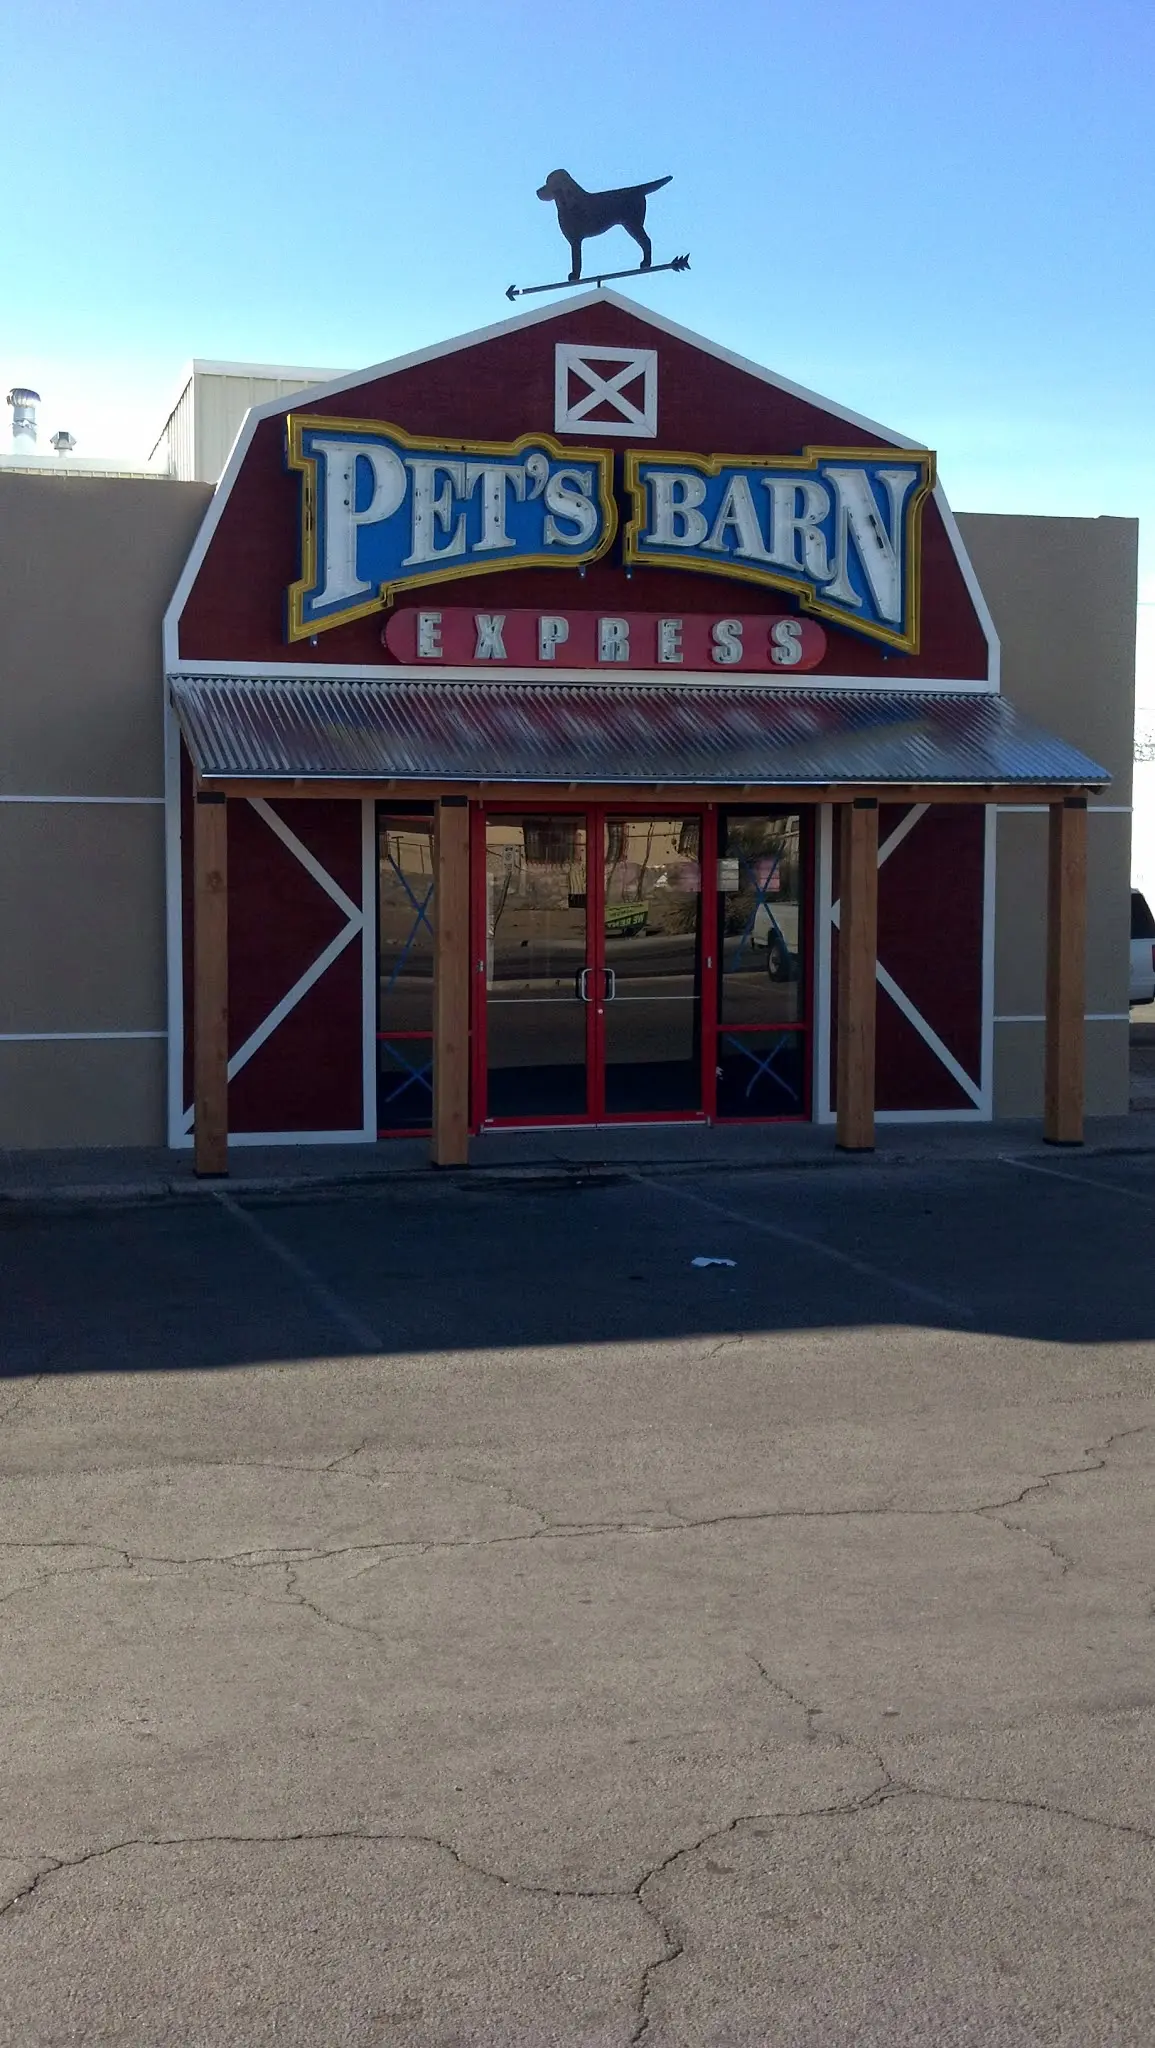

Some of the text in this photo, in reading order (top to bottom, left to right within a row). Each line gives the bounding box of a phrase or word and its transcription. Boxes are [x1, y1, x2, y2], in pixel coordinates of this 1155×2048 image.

[311, 439, 917, 623] PET'S BARN
[416, 611, 802, 665] EXPRESS
